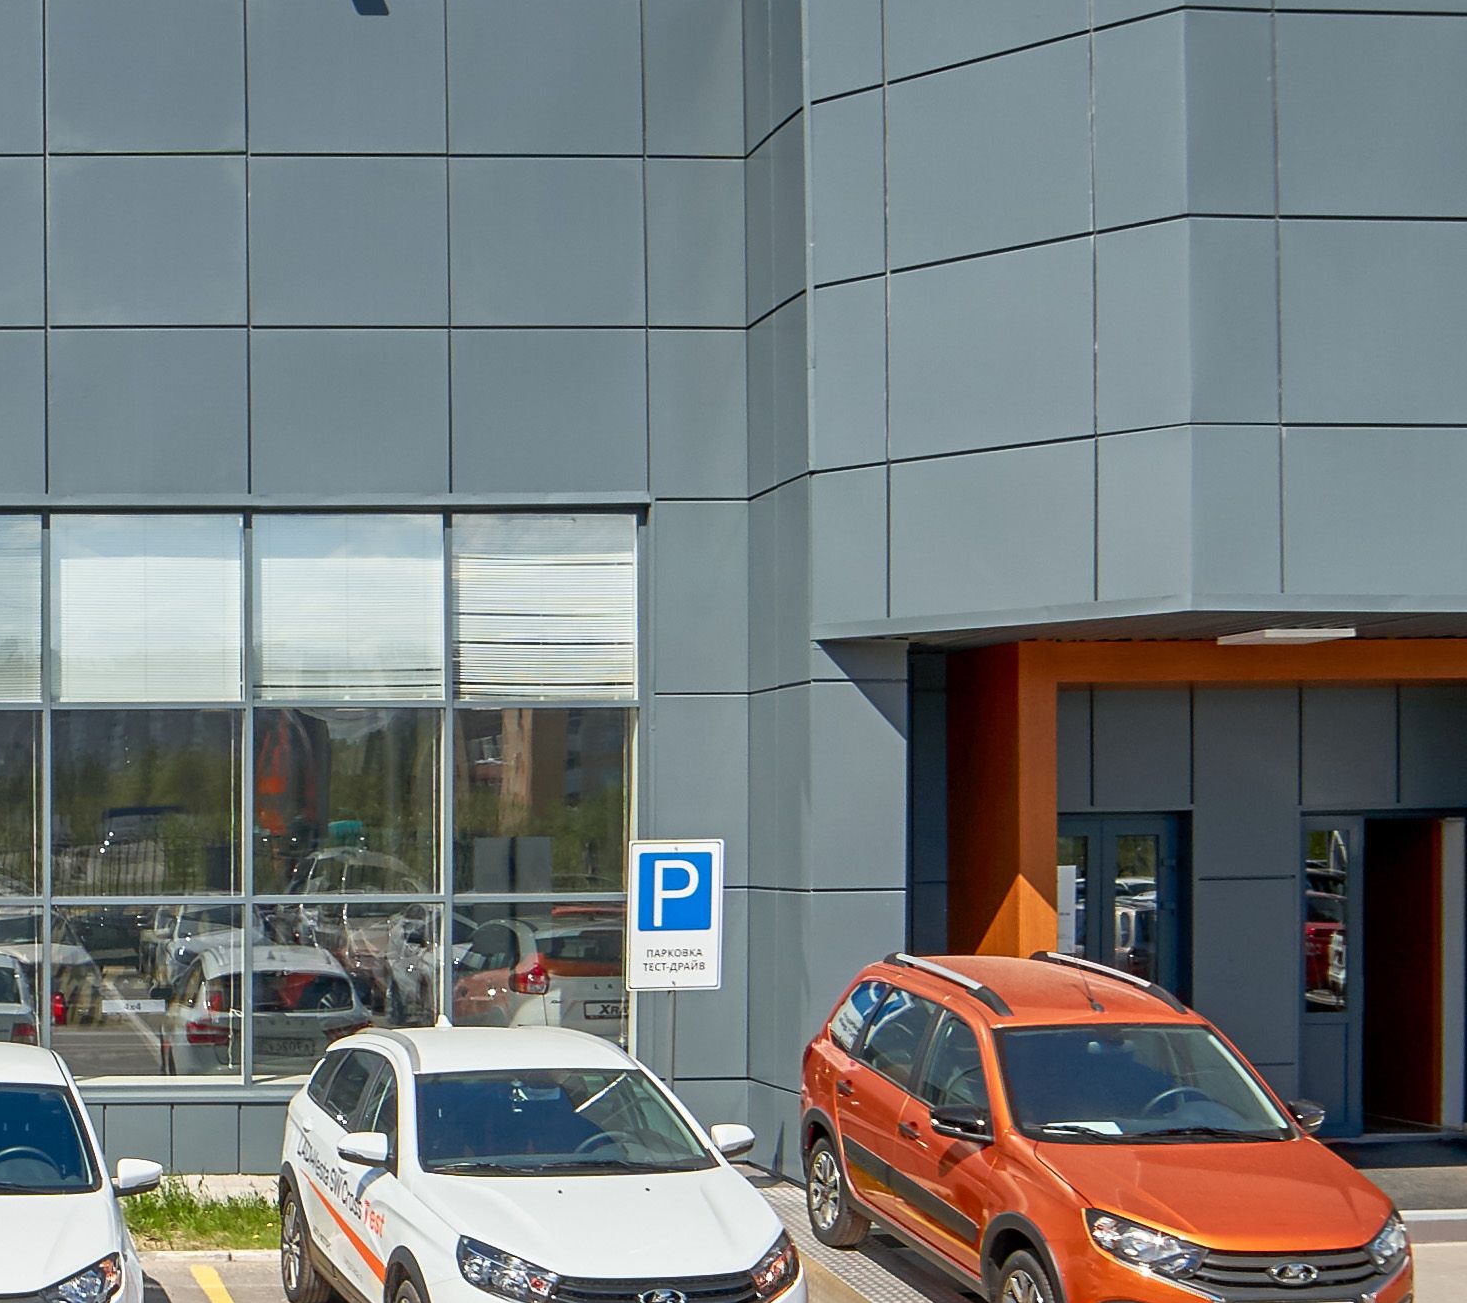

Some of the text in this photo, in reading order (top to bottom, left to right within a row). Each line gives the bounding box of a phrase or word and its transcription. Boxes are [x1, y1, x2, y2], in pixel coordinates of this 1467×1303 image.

[653, 859, 699, 927] P
[643, 960, 706, 973] ТЕСТ-ДРАЙВ
[646, 949, 703, 959] ПАРКОВКА
[363, 1199, 385, 1237] Test
